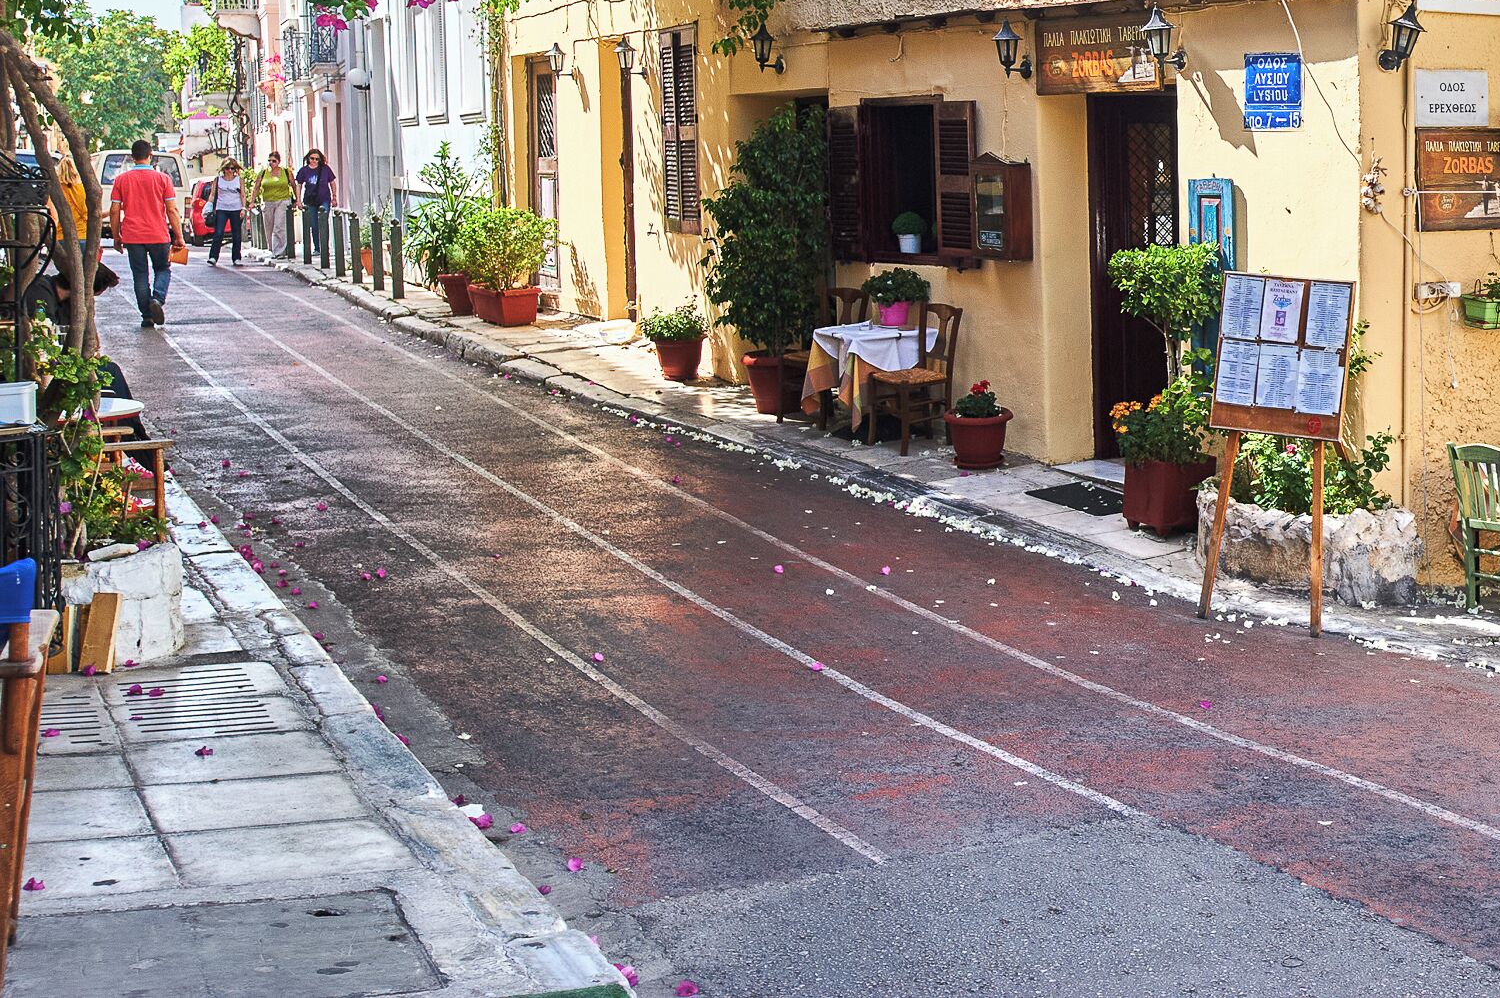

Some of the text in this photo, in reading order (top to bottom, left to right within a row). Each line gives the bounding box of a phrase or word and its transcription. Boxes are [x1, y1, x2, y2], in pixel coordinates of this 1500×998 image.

[1117, 24, 1148, 42] ΤΑΒΕΡΝ
[1257, 57, 1288, 69] ΟΔΟΣ
[1254, 72, 1290, 85] ΛΥΣΙΟΥ
[1439, 82, 1466, 92] ΟΔΟΣ
[1253, 89, 1289, 102] LYSIOU
[1429, 103, 1477, 114] ΕΡΕΧΘΕΩΣ
